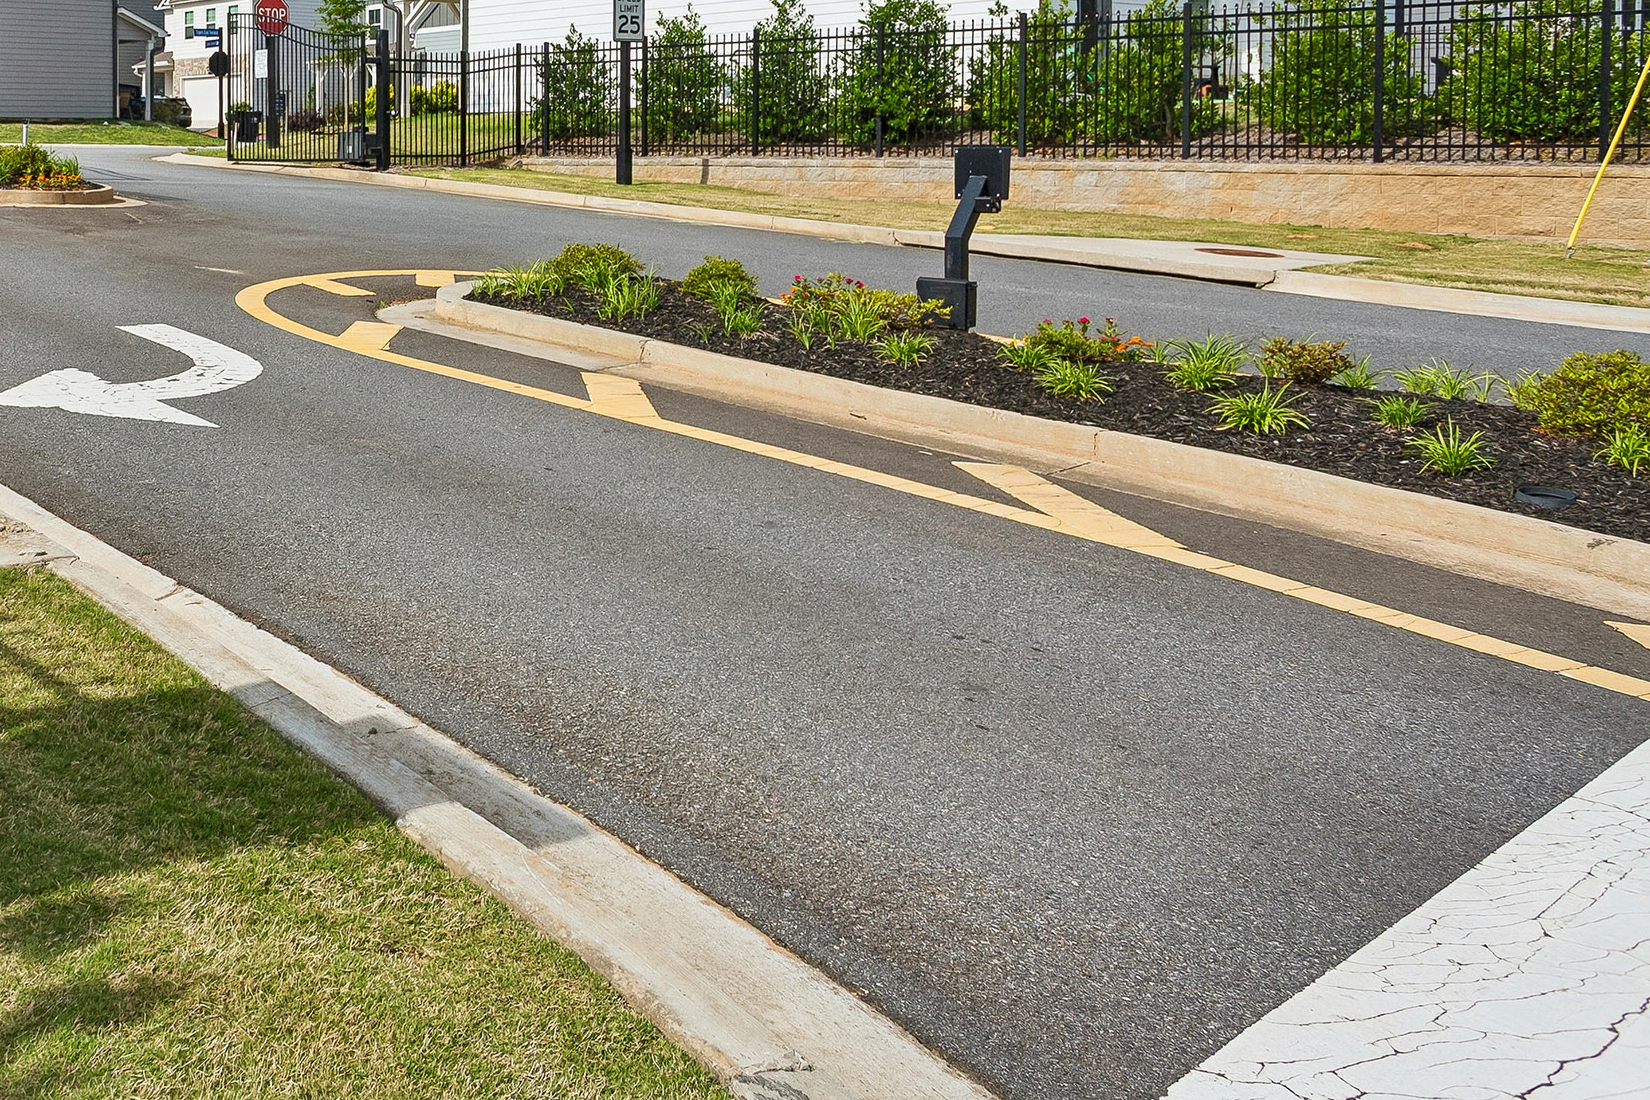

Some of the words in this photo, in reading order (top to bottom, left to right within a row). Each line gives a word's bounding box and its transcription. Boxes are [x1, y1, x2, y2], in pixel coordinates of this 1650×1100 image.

[258, 7, 286, 23] STOP
[620, 4, 639, 13] LIMIT
[618, 14, 640, 34] 25
